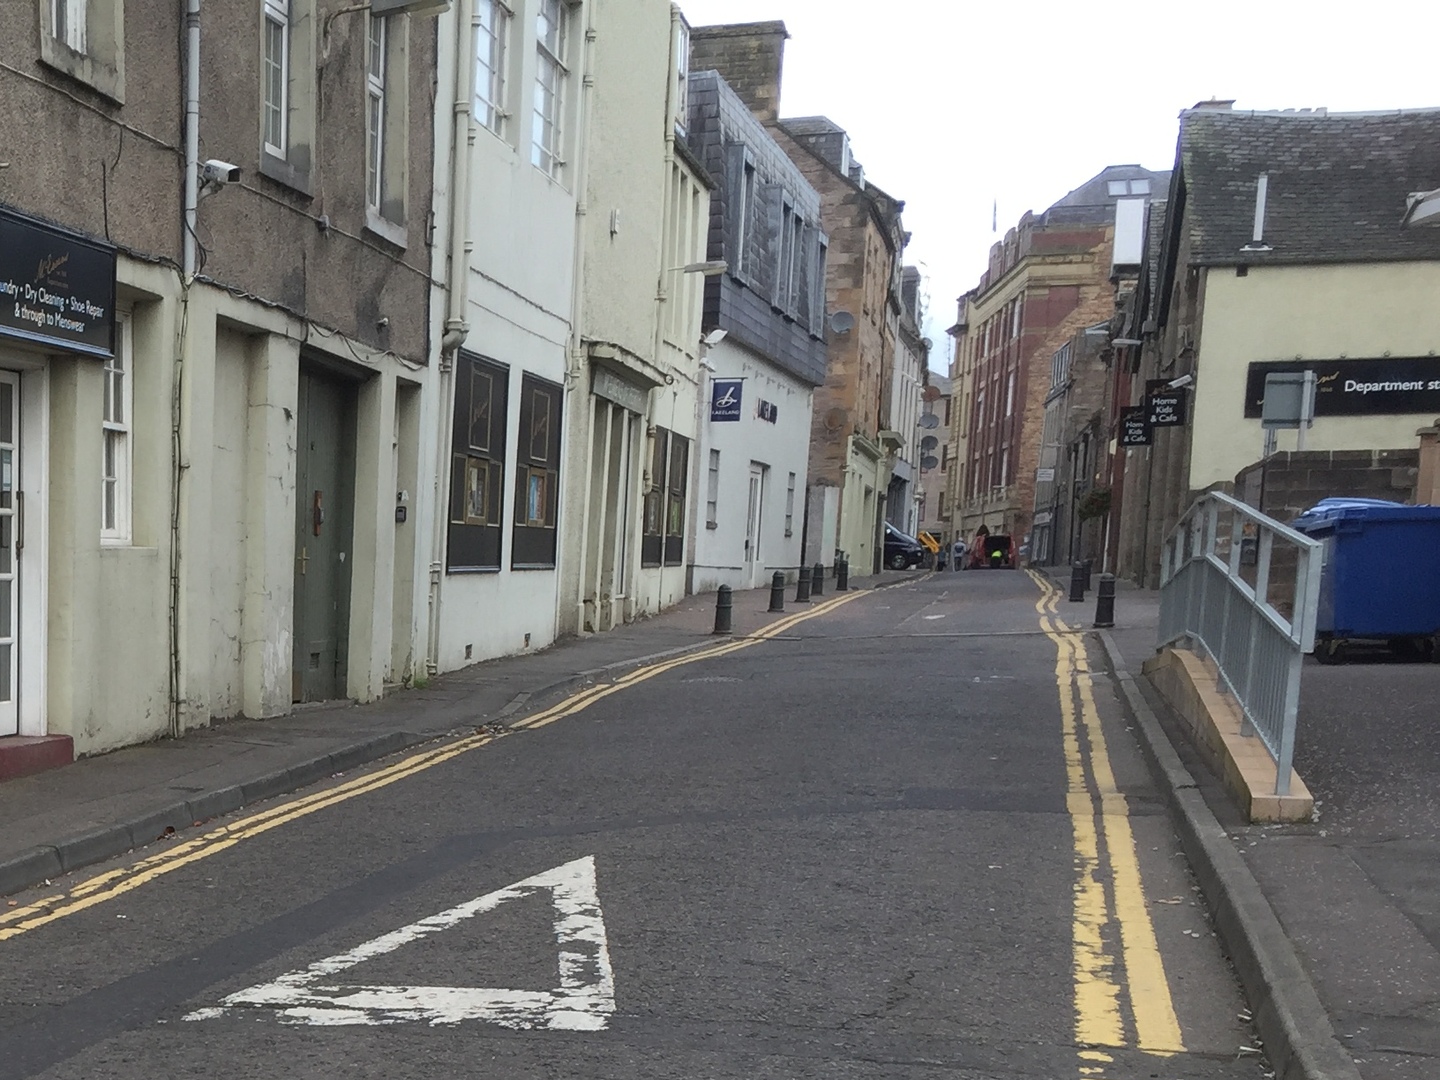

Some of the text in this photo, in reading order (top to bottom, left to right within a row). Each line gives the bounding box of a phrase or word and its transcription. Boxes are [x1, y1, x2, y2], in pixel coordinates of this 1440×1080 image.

[25, 283, 38, 304] Dry
[38, 287, 65, 312] Cleaning
[70, 296, 85, 313] Shoe
[85, 300, 105, 320] Repair
[14, 302, 85, 332] & through to Menswear
[1344, 380, 1424, 395] Department
[1427, 380, 1440, 390] st
